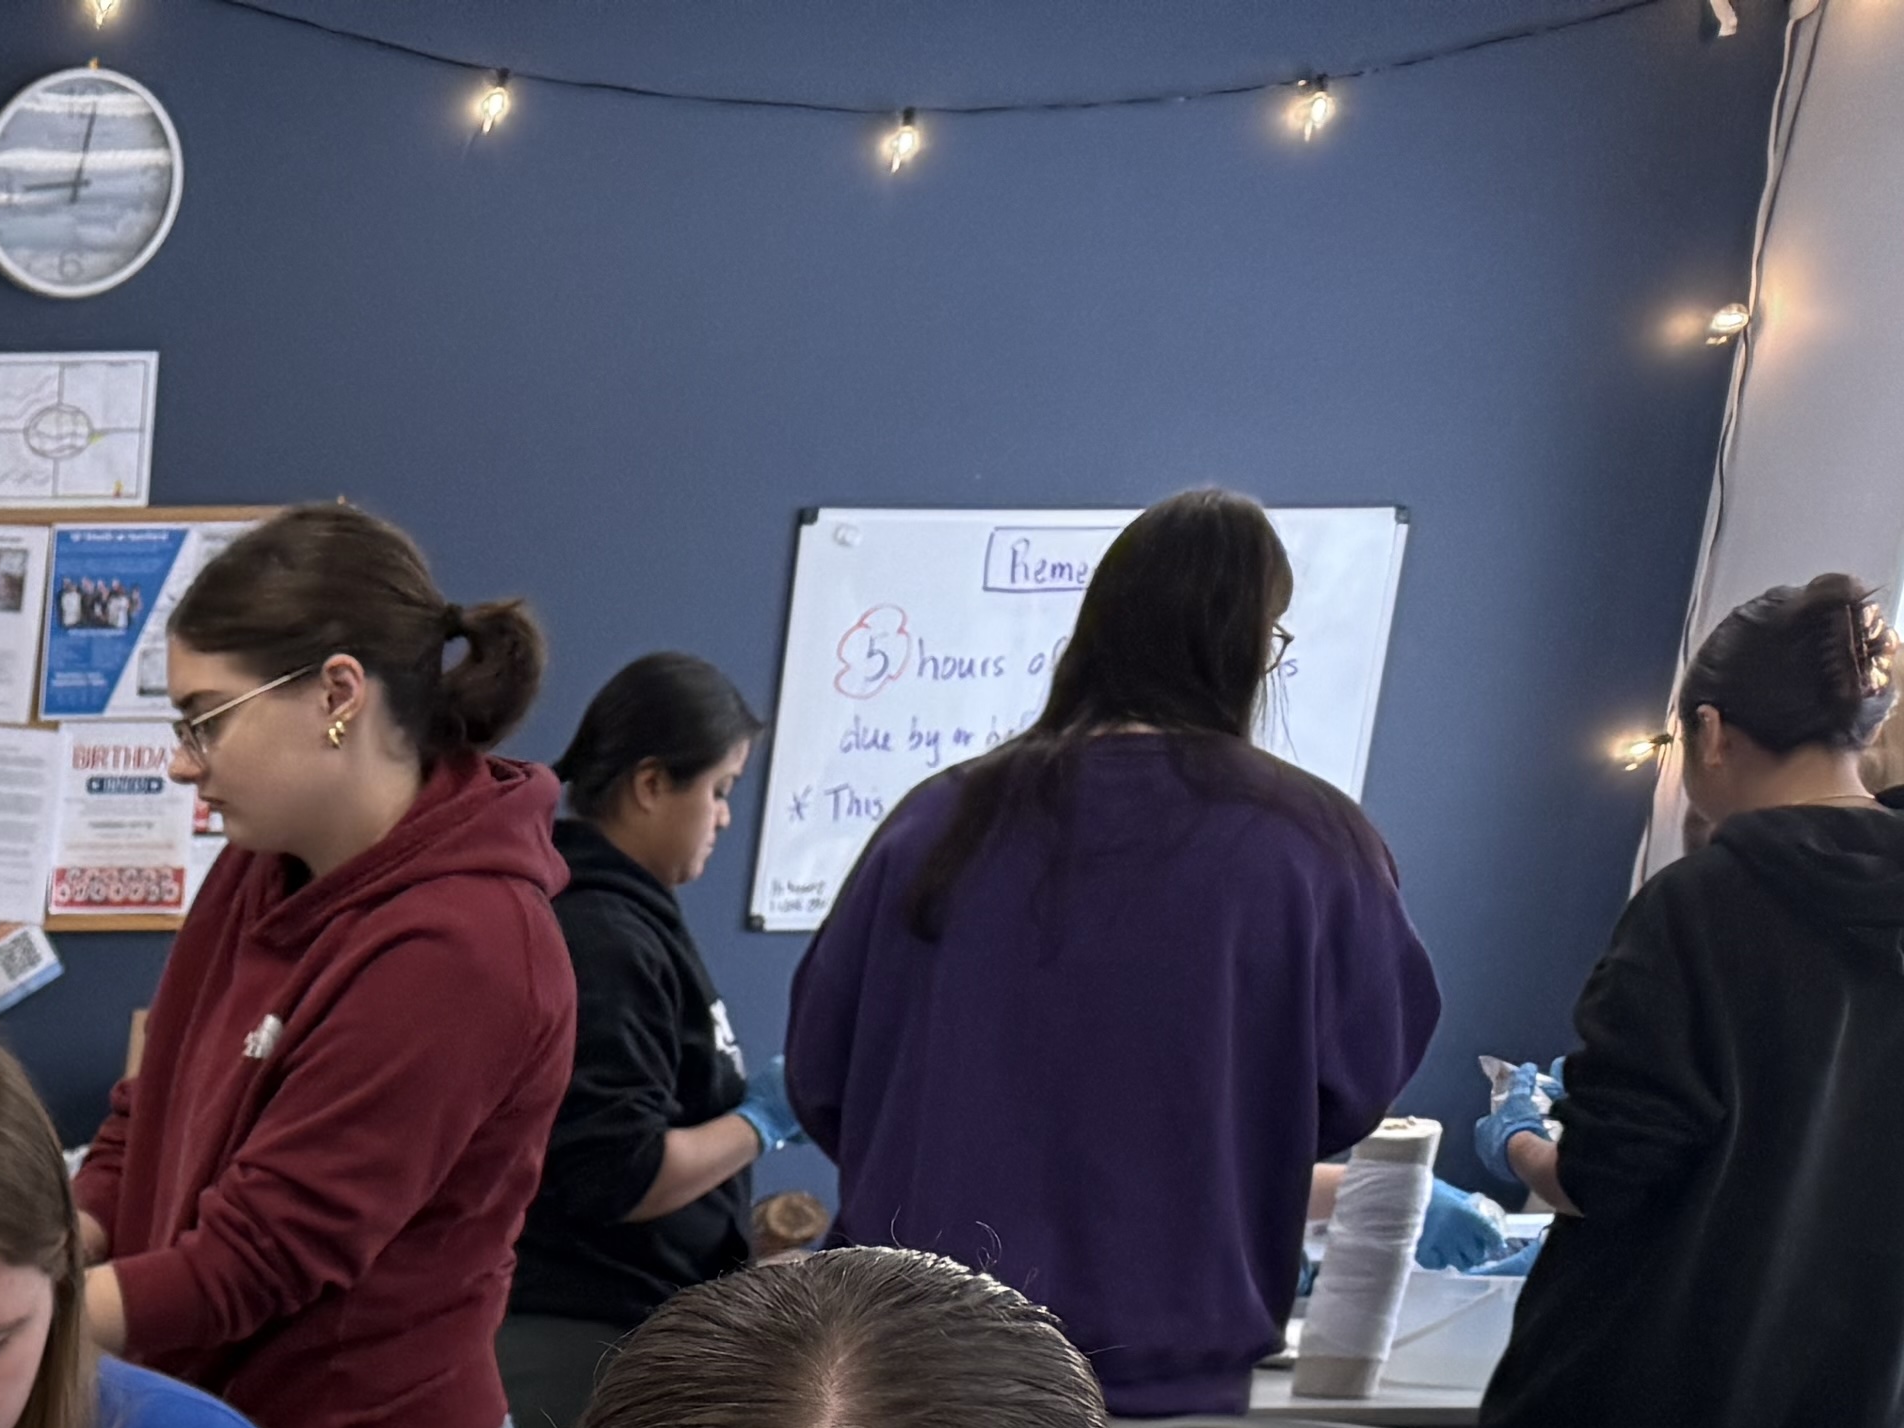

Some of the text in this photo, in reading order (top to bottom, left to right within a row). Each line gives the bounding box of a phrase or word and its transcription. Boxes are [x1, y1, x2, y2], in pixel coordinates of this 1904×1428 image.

[1009, 537, 1089, 584] Reme
[864, 632, 890, 683] 5
[916, 636, 1006, 681] hours
[72, 743, 169, 770] BIRTHDA
[840, 714, 893, 753] due
[908, 715, 941, 768] by
[824, 784, 884, 822] This
